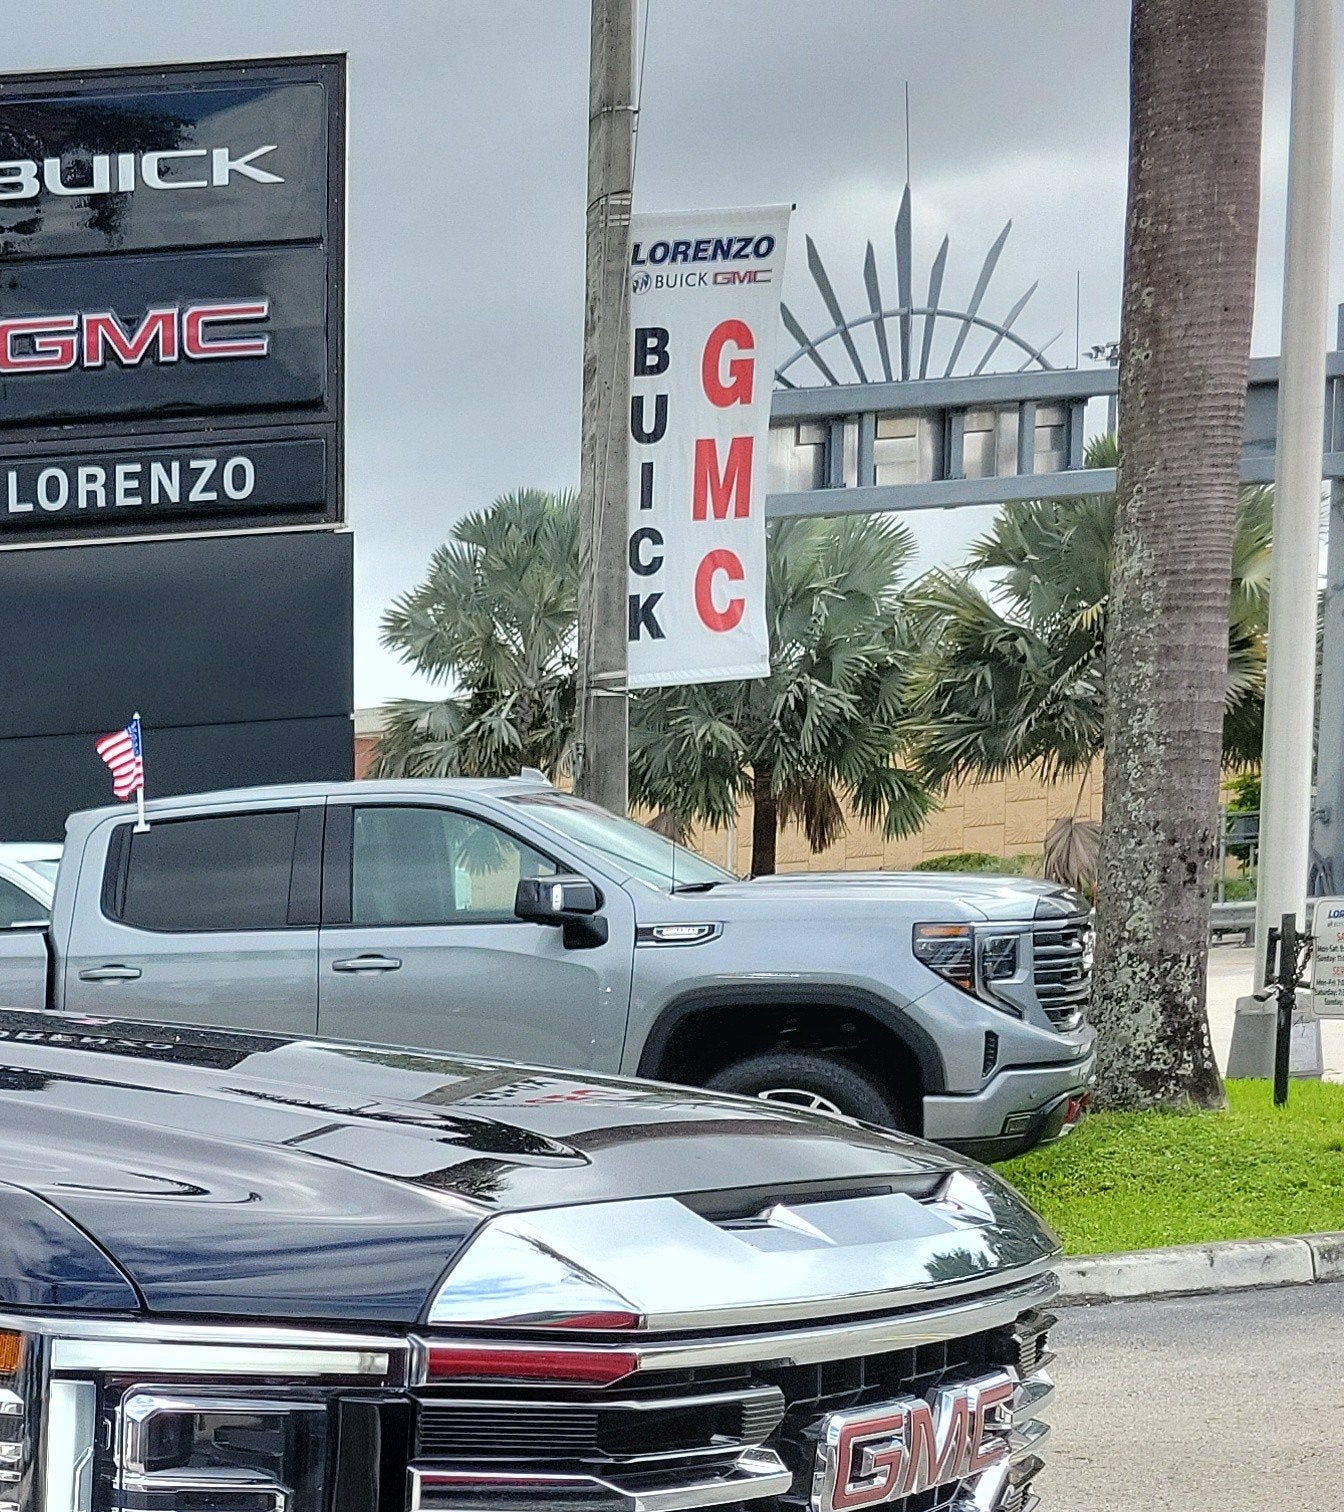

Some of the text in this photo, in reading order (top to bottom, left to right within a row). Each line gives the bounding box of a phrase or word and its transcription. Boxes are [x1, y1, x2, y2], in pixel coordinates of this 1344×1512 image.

[631, 234, 776, 266] LORENZO
[655, 268, 773, 289] BUICK GMC
[7, 455, 257, 514] LORENZO
[628, 326, 671, 643] BUICK
[692, 318, 756, 634] GMC
